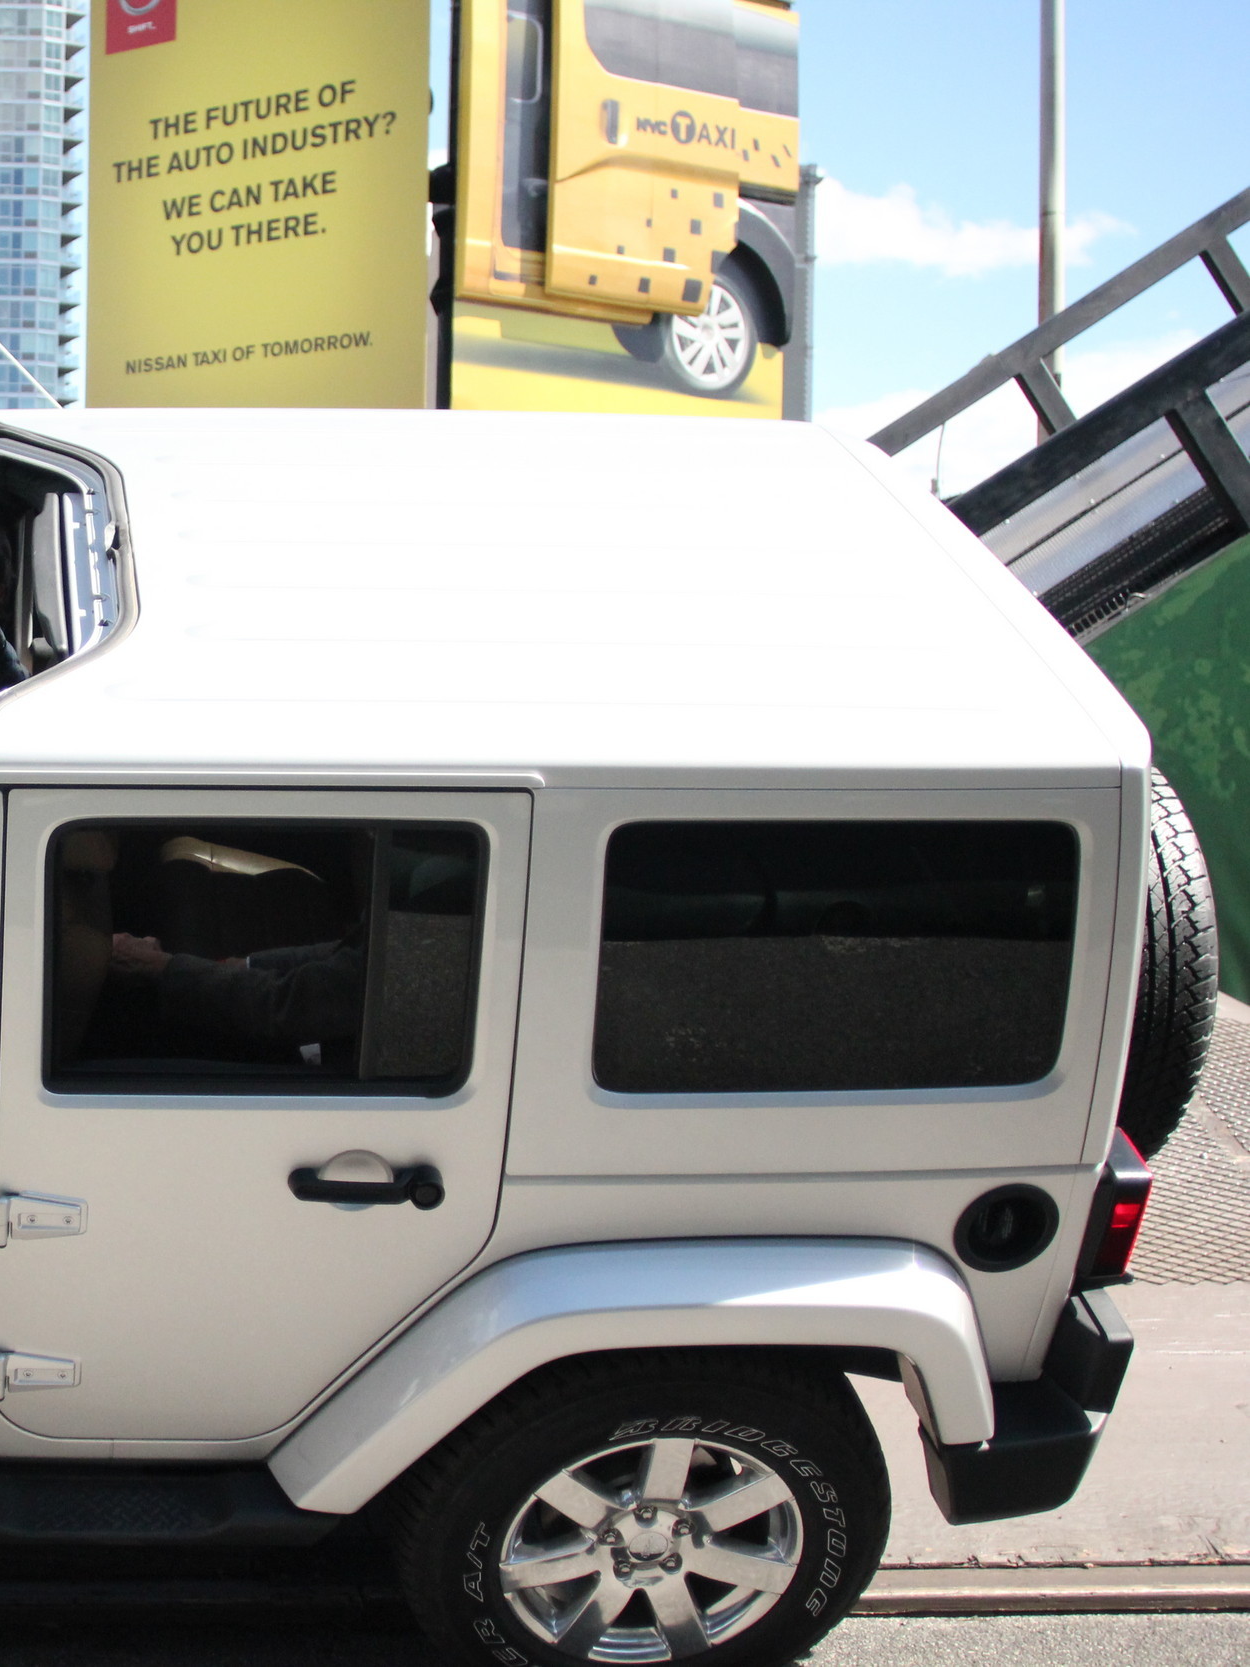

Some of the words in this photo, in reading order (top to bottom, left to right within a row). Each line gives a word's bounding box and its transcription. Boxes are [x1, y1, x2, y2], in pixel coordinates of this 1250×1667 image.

[150, 112, 197, 140] THE
[205, 89, 309, 130] FUTURE
[318, 79, 356, 109] OF
[113, 156, 160, 184] THE
[167, 143, 234, 175] AUTO
[242, 111, 397, 161] INDUSTRY?
[162, 194, 201, 221] WE
[209, 184, 262, 213] CAN
[269, 171, 337, 205] TAKE
[171, 228, 223, 256] YOU
[231, 212, 327, 246] THERE.
[126, 353, 187, 375] NISSAN
[192, 349, 227, 367] TAXI
[232, 345, 255, 362] OF
[261, 331, 374, 359] TOMORROW.
[609, 1416, 847, 1617] BRIDGESTONE
